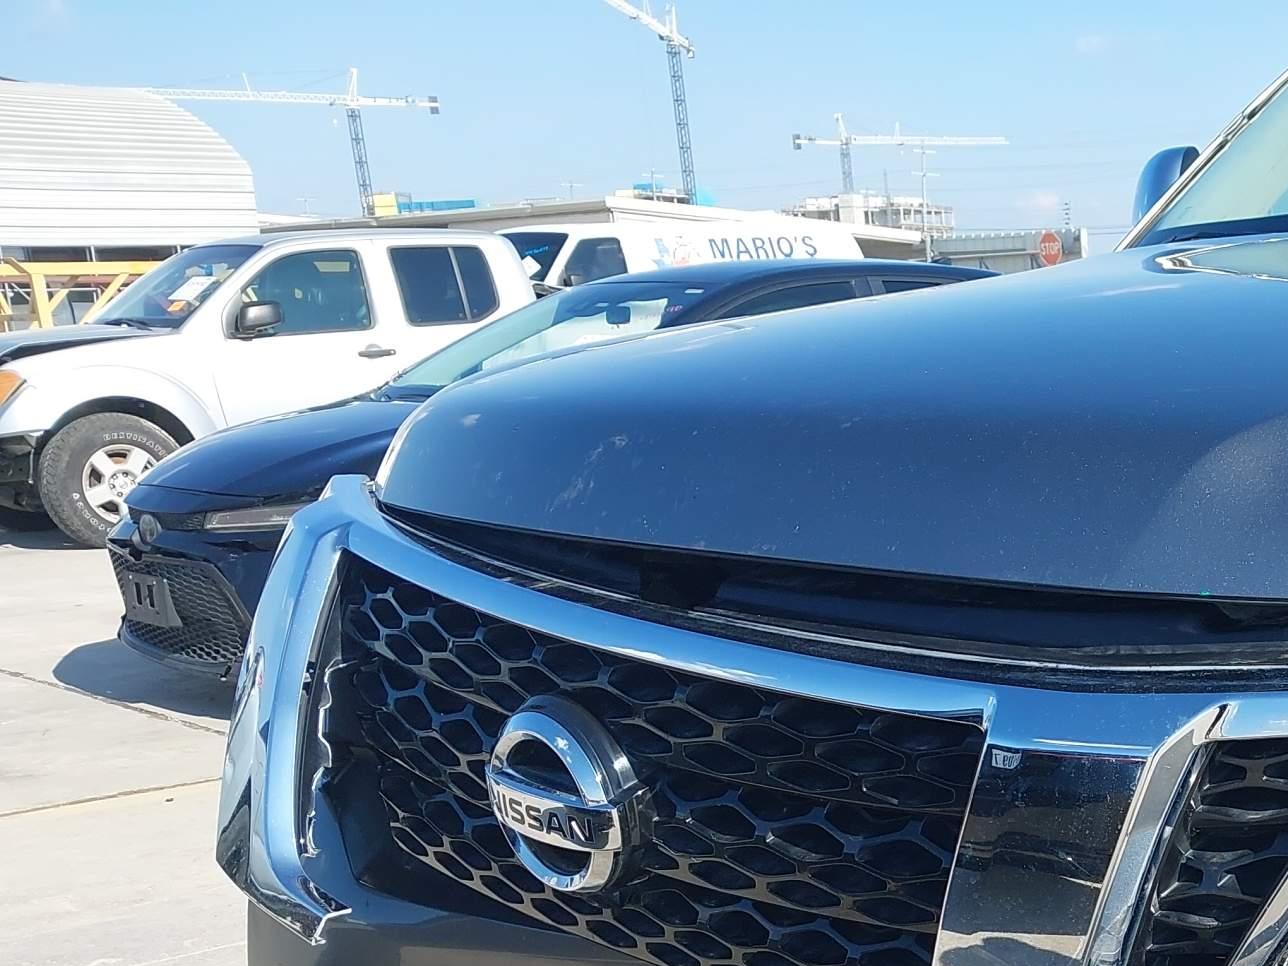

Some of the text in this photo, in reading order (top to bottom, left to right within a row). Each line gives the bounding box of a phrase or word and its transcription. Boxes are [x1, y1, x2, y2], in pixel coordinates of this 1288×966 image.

[708, 236, 818, 259] MARIO'S
[1040, 242, 1060, 256] STOP
[488, 780, 595, 843] NISSAN
